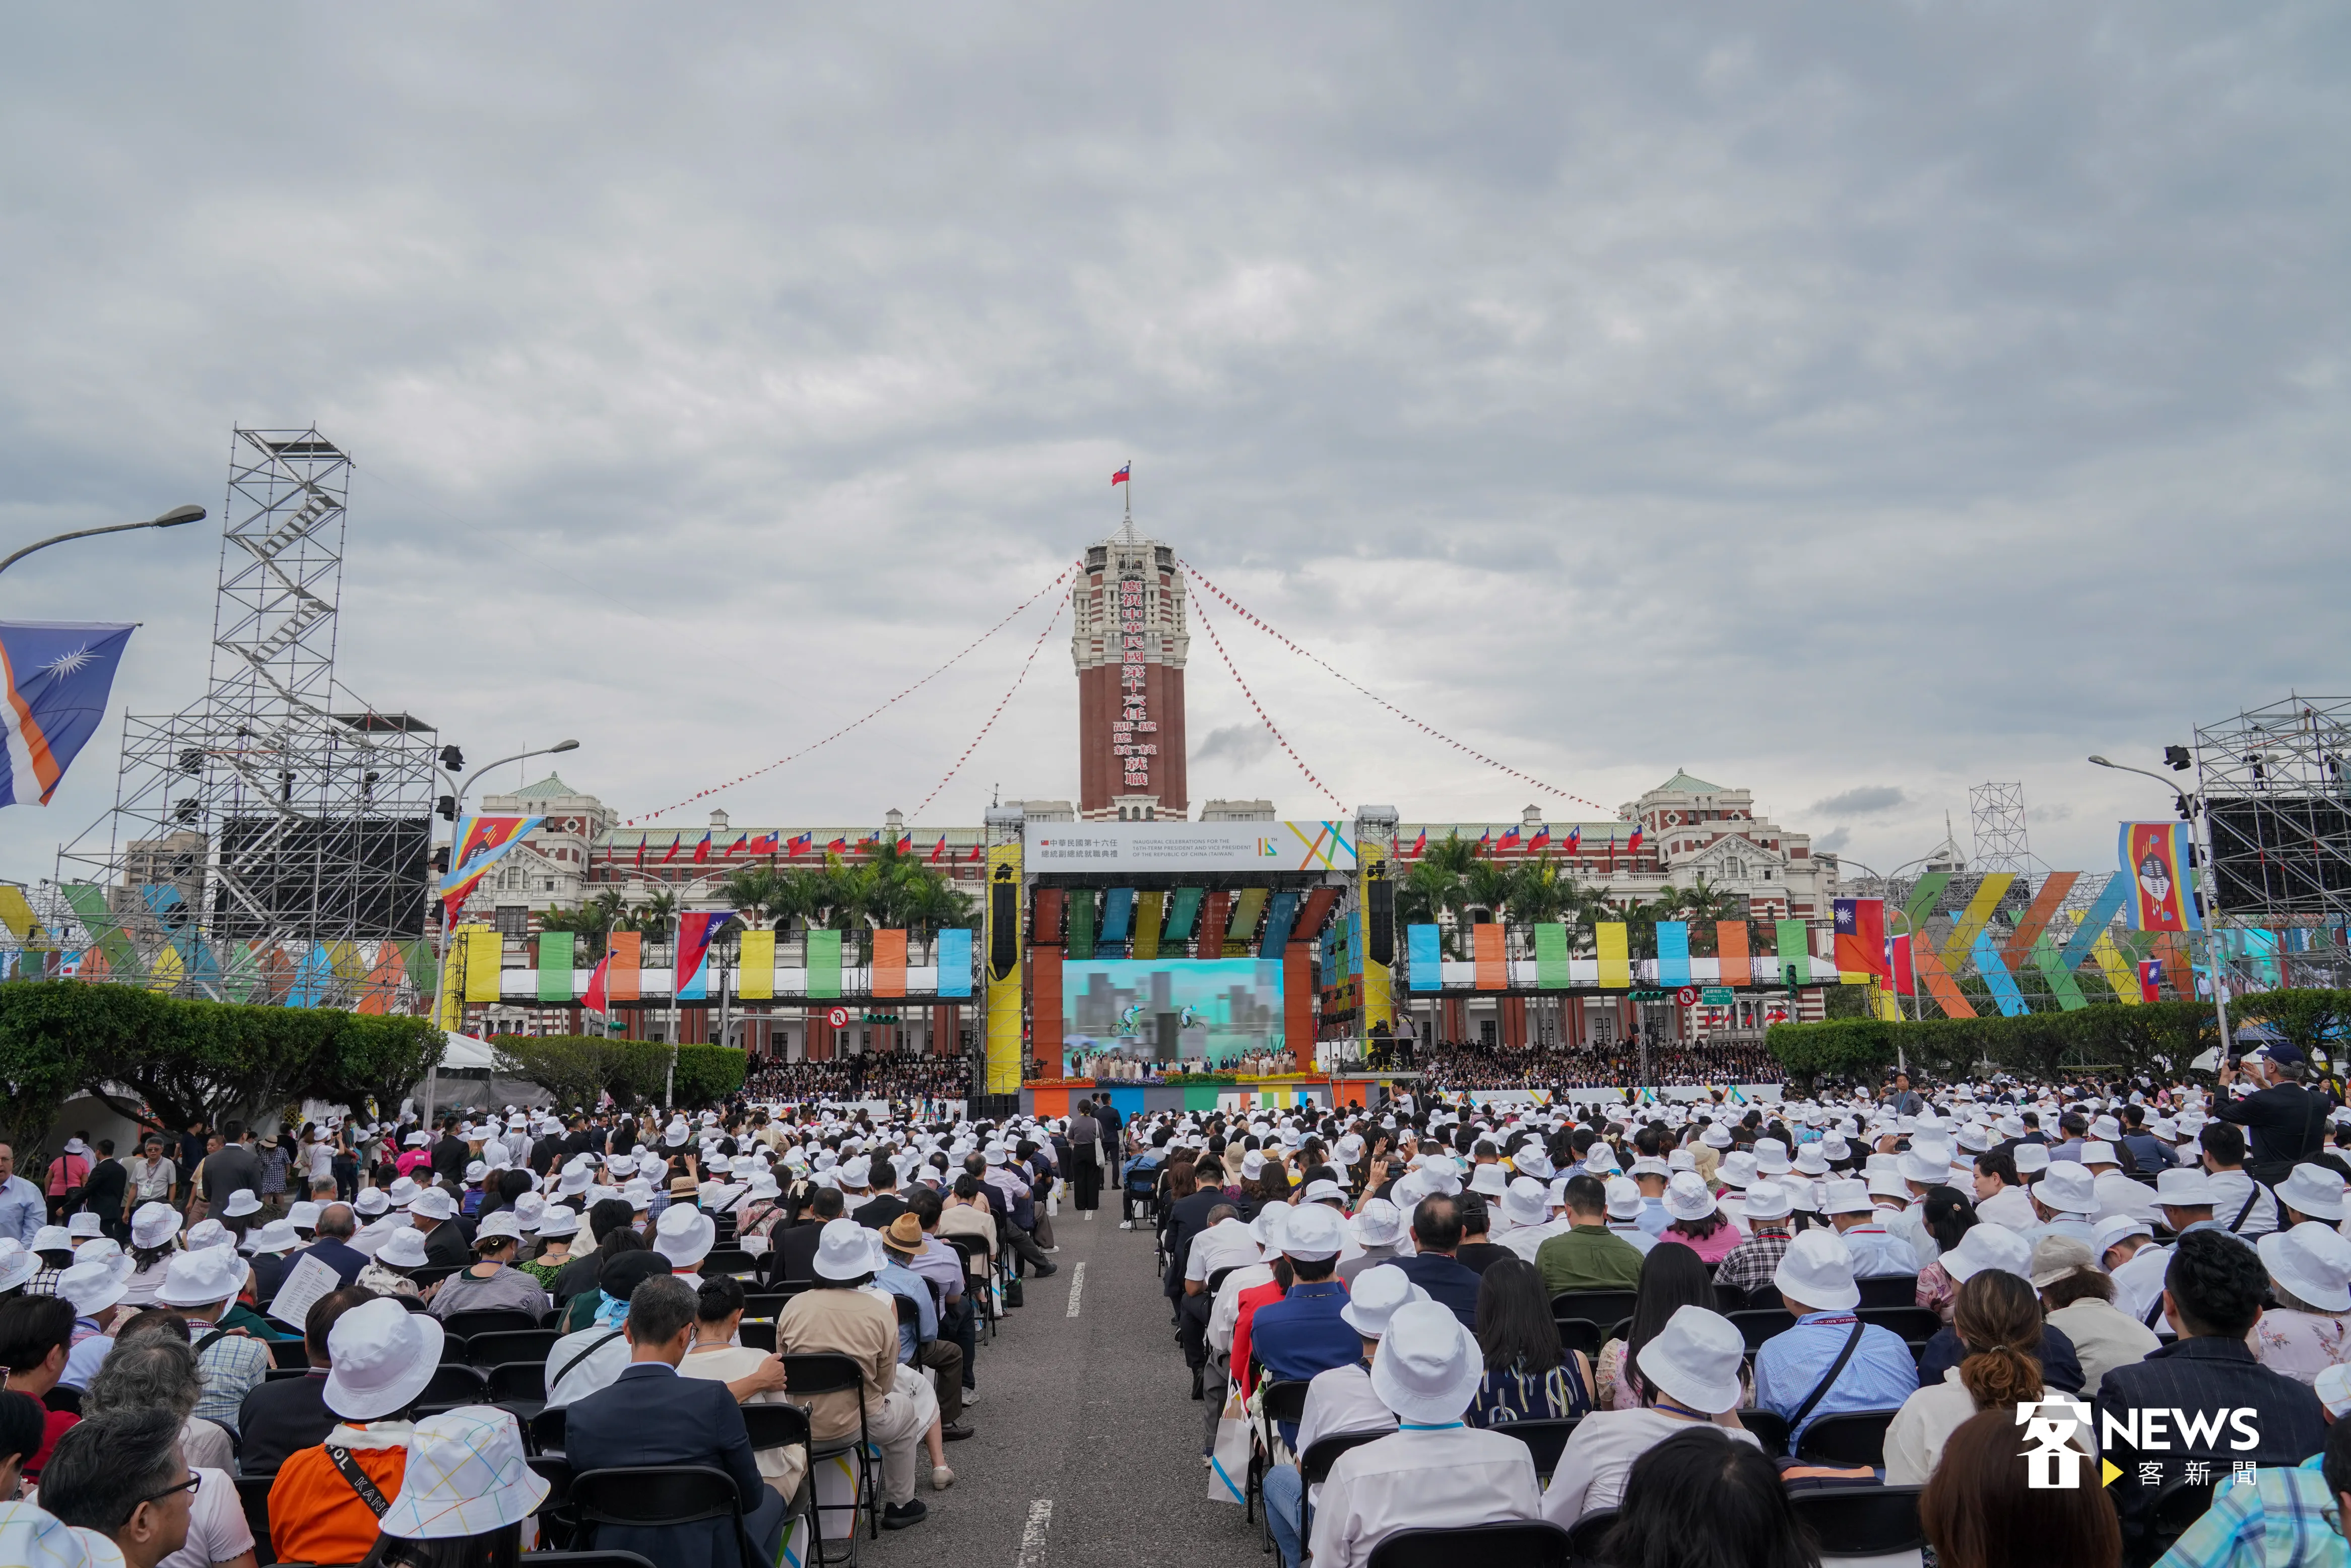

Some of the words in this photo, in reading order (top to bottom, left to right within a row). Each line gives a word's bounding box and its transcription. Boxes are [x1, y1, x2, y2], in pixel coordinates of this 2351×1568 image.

[1120, 580, 1146, 721] 慶祝中華民國第十六任
[1113, 721, 1132, 755] 副總統
[1125, 756, 1148, 786] 就職
[1041, 850, 1118, 858] 總統副總統就職典禮
[1050, 839, 1118, 847] 中華民國第十六任
